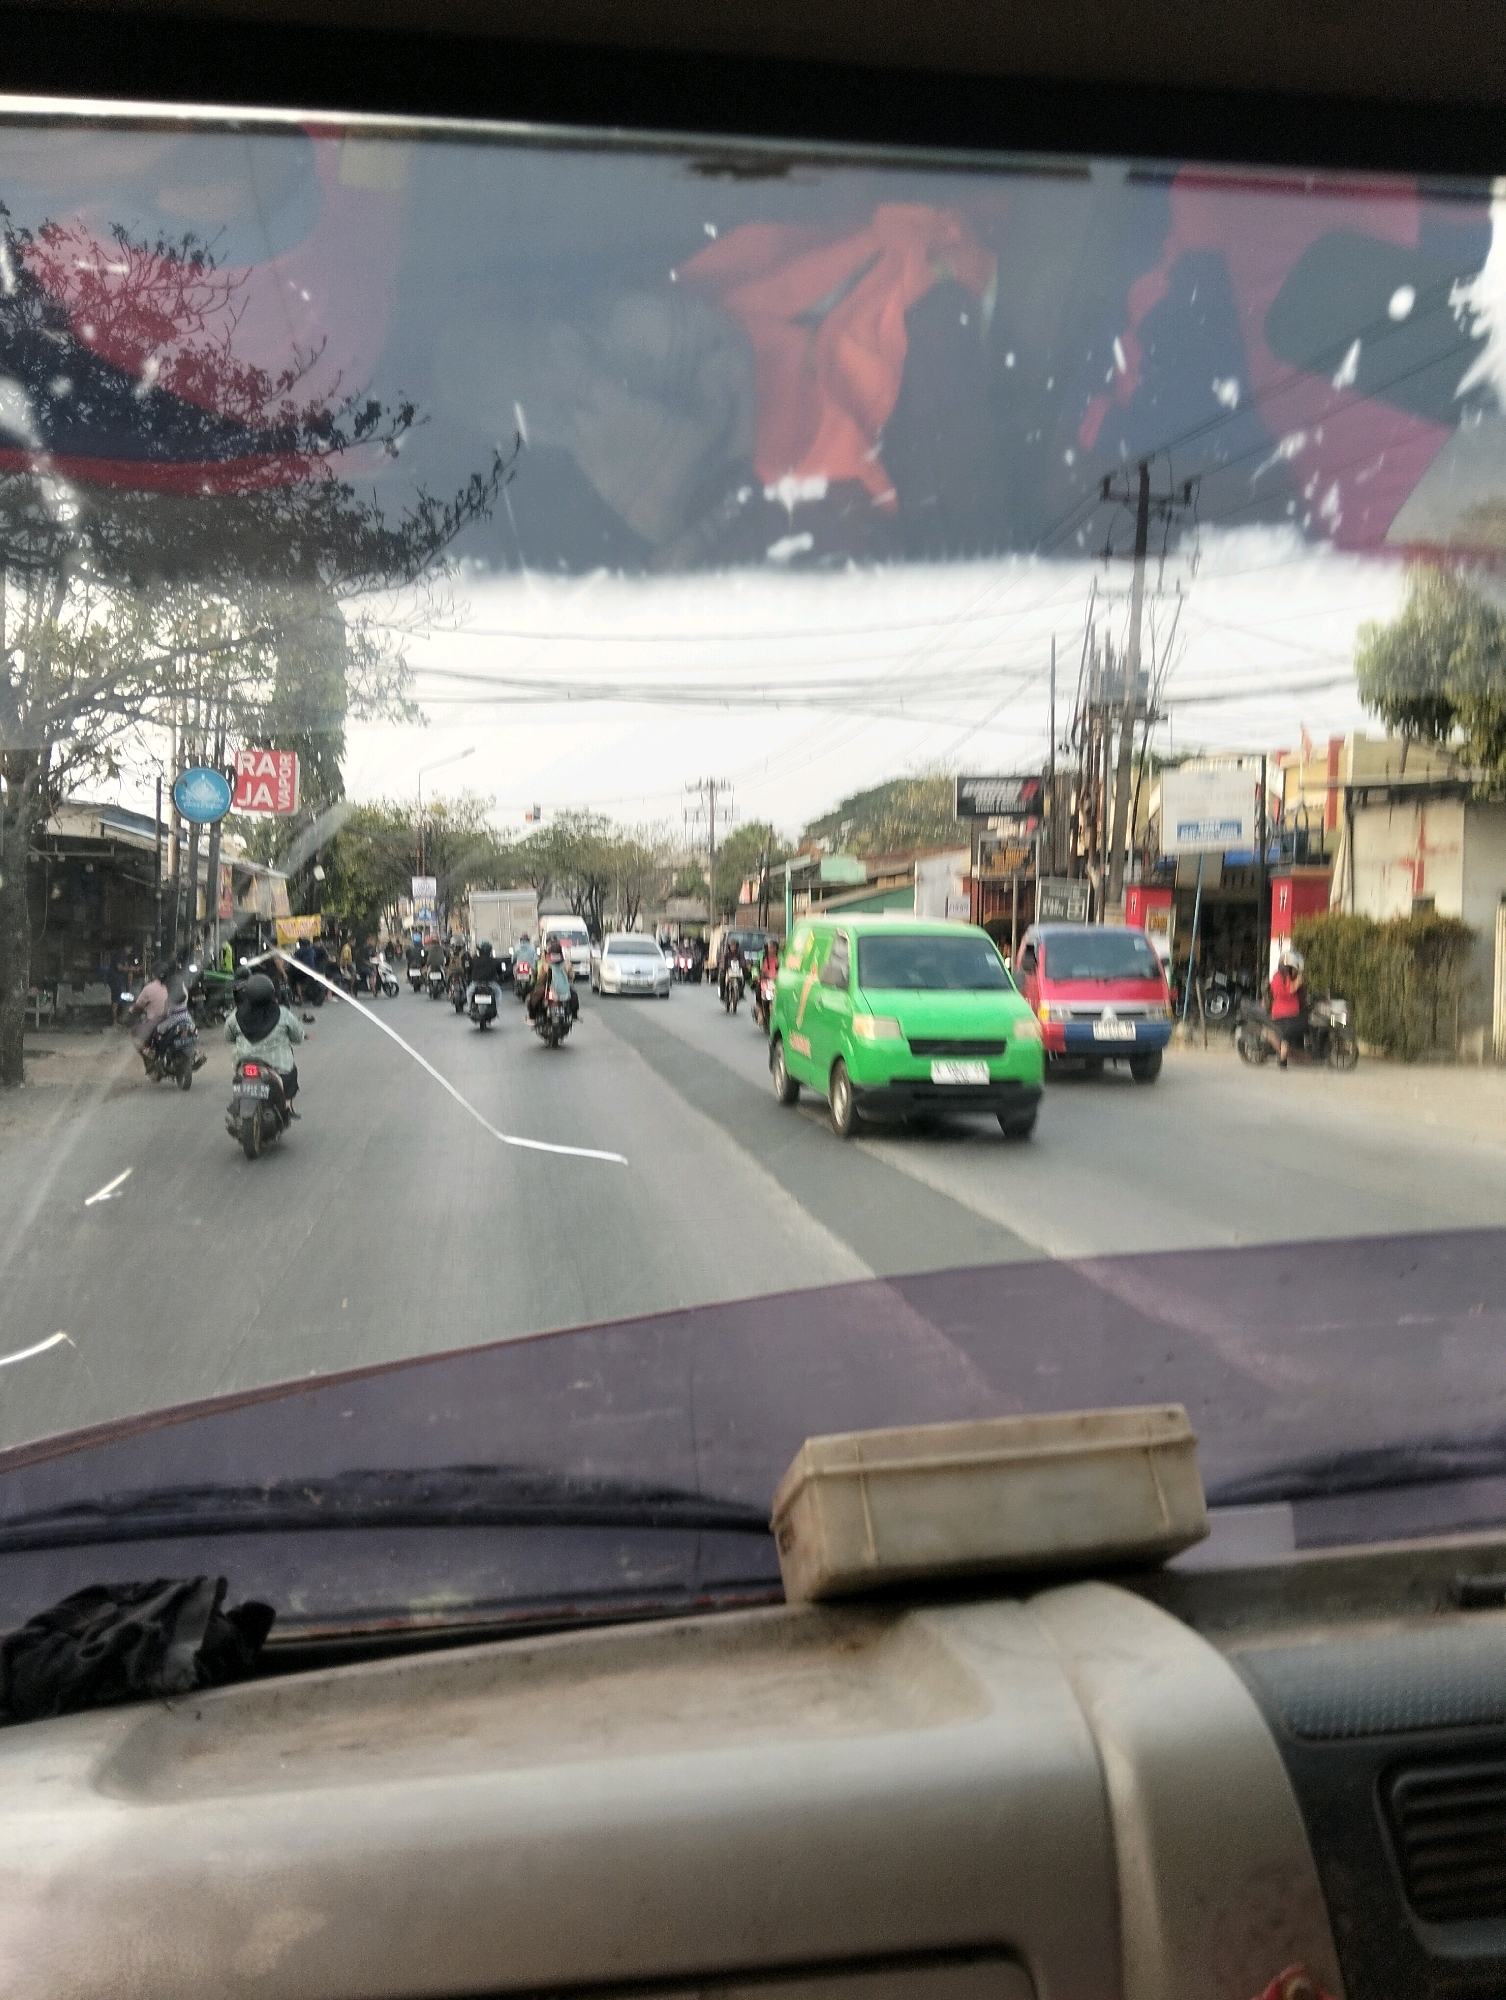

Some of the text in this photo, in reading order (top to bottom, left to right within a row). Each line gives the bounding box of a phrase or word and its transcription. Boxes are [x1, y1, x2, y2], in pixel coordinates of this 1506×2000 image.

[237, 751, 277, 778] RA
[278, 752, 292, 811] VAPOR
[236, 782, 275, 809] JA
